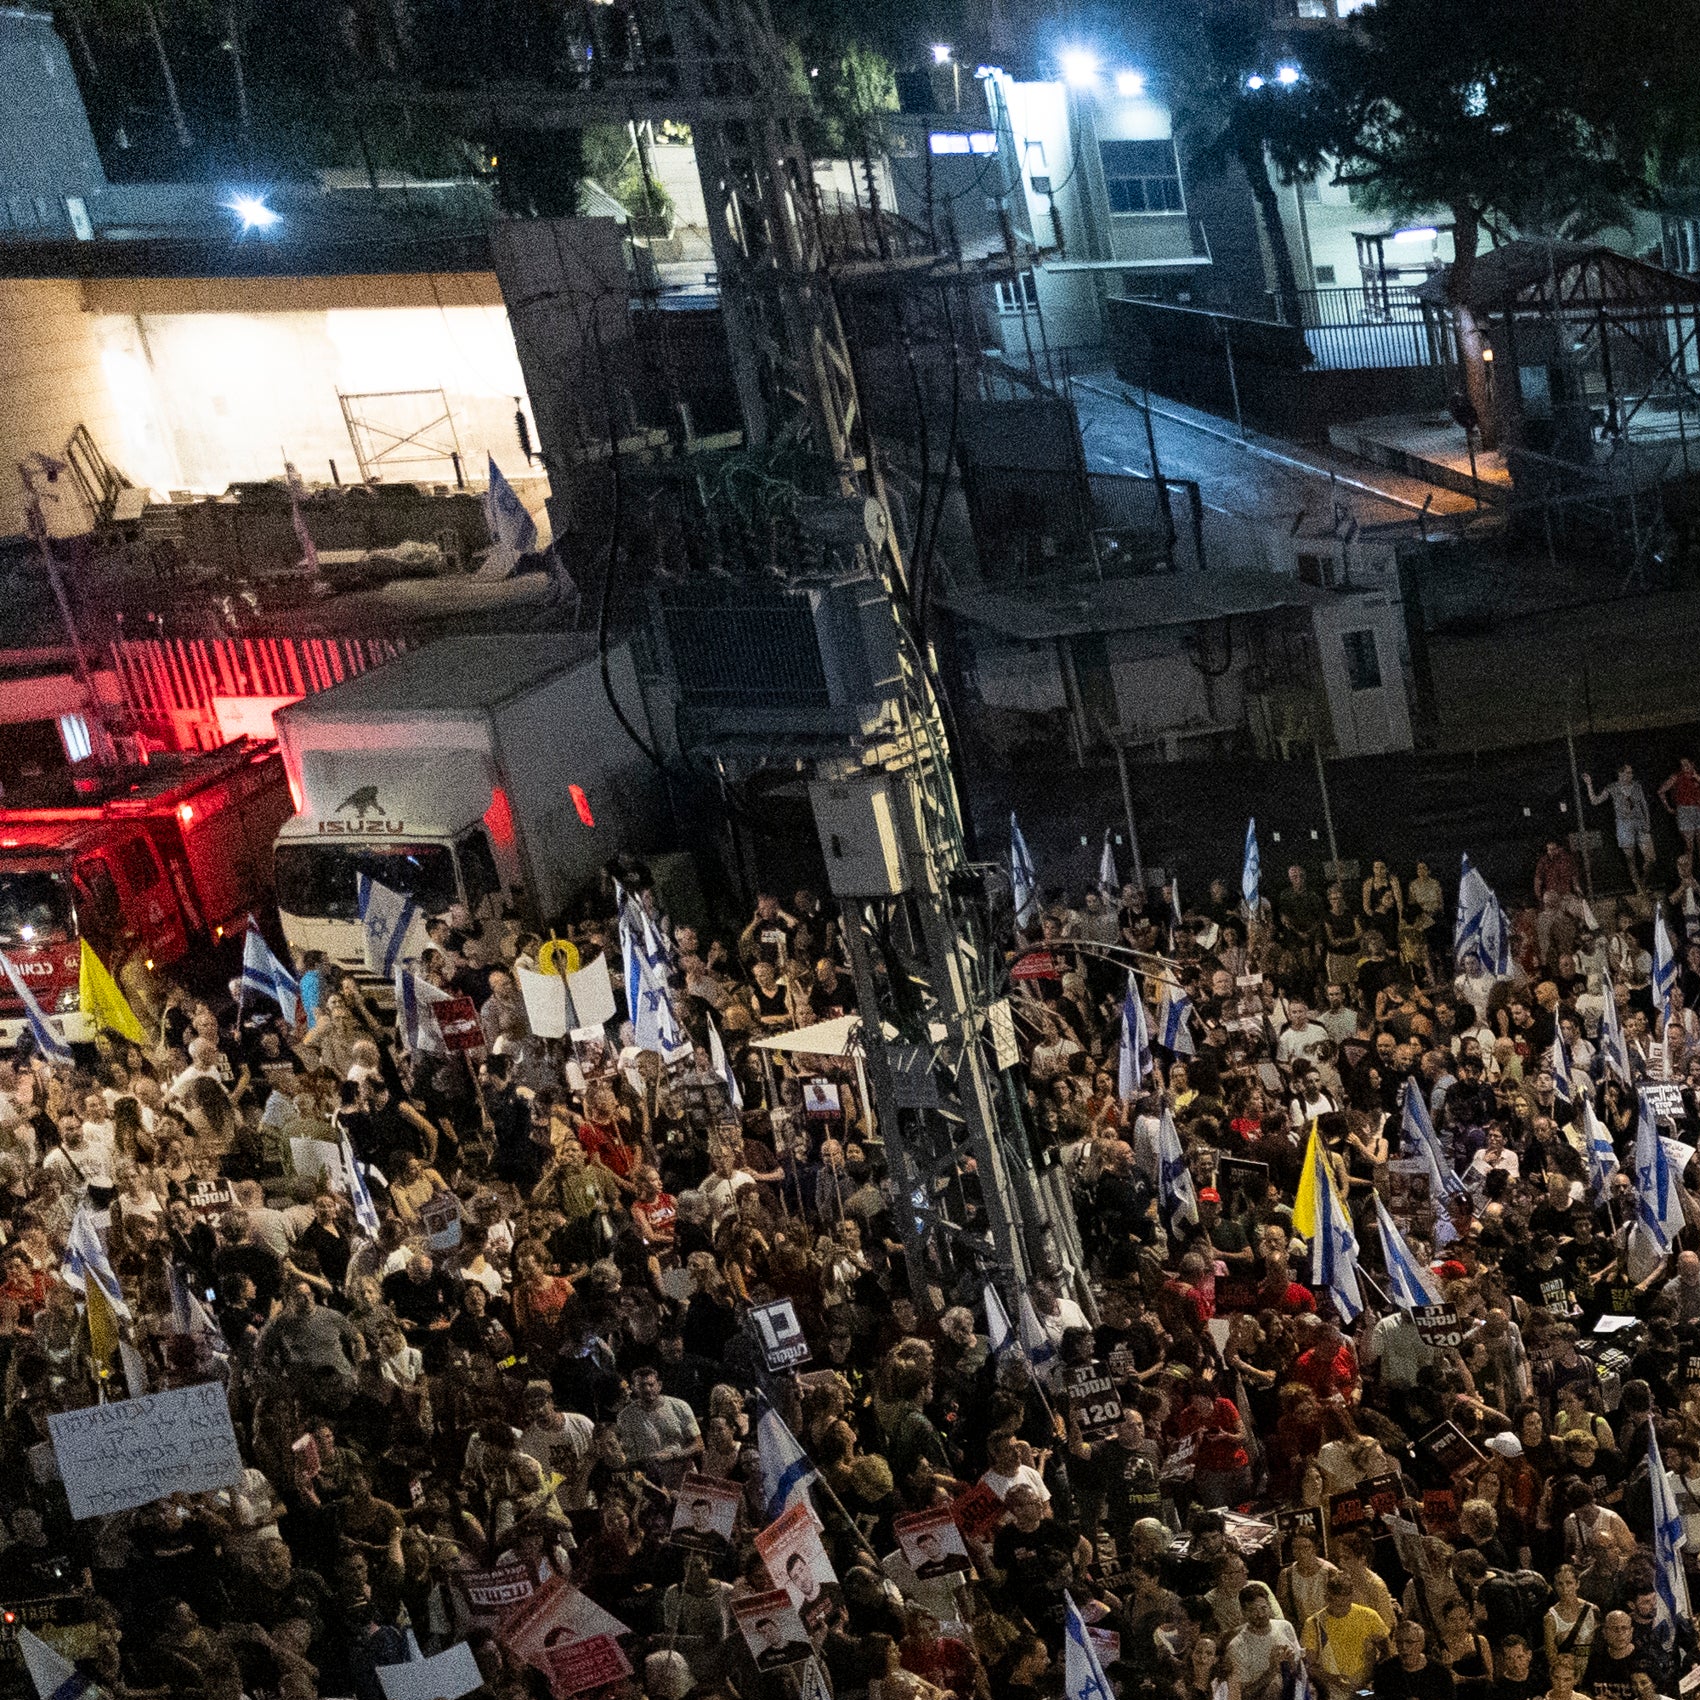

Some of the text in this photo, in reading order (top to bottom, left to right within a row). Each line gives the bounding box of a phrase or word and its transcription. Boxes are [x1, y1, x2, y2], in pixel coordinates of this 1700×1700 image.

[318, 819, 405, 835] ISUZU
[752, 1303, 799, 1346] כן
[1420, 1329, 1462, 1346] 120
[1068, 1377, 1112, 1397] עסקה
[1078, 1400, 1119, 1424] 120
